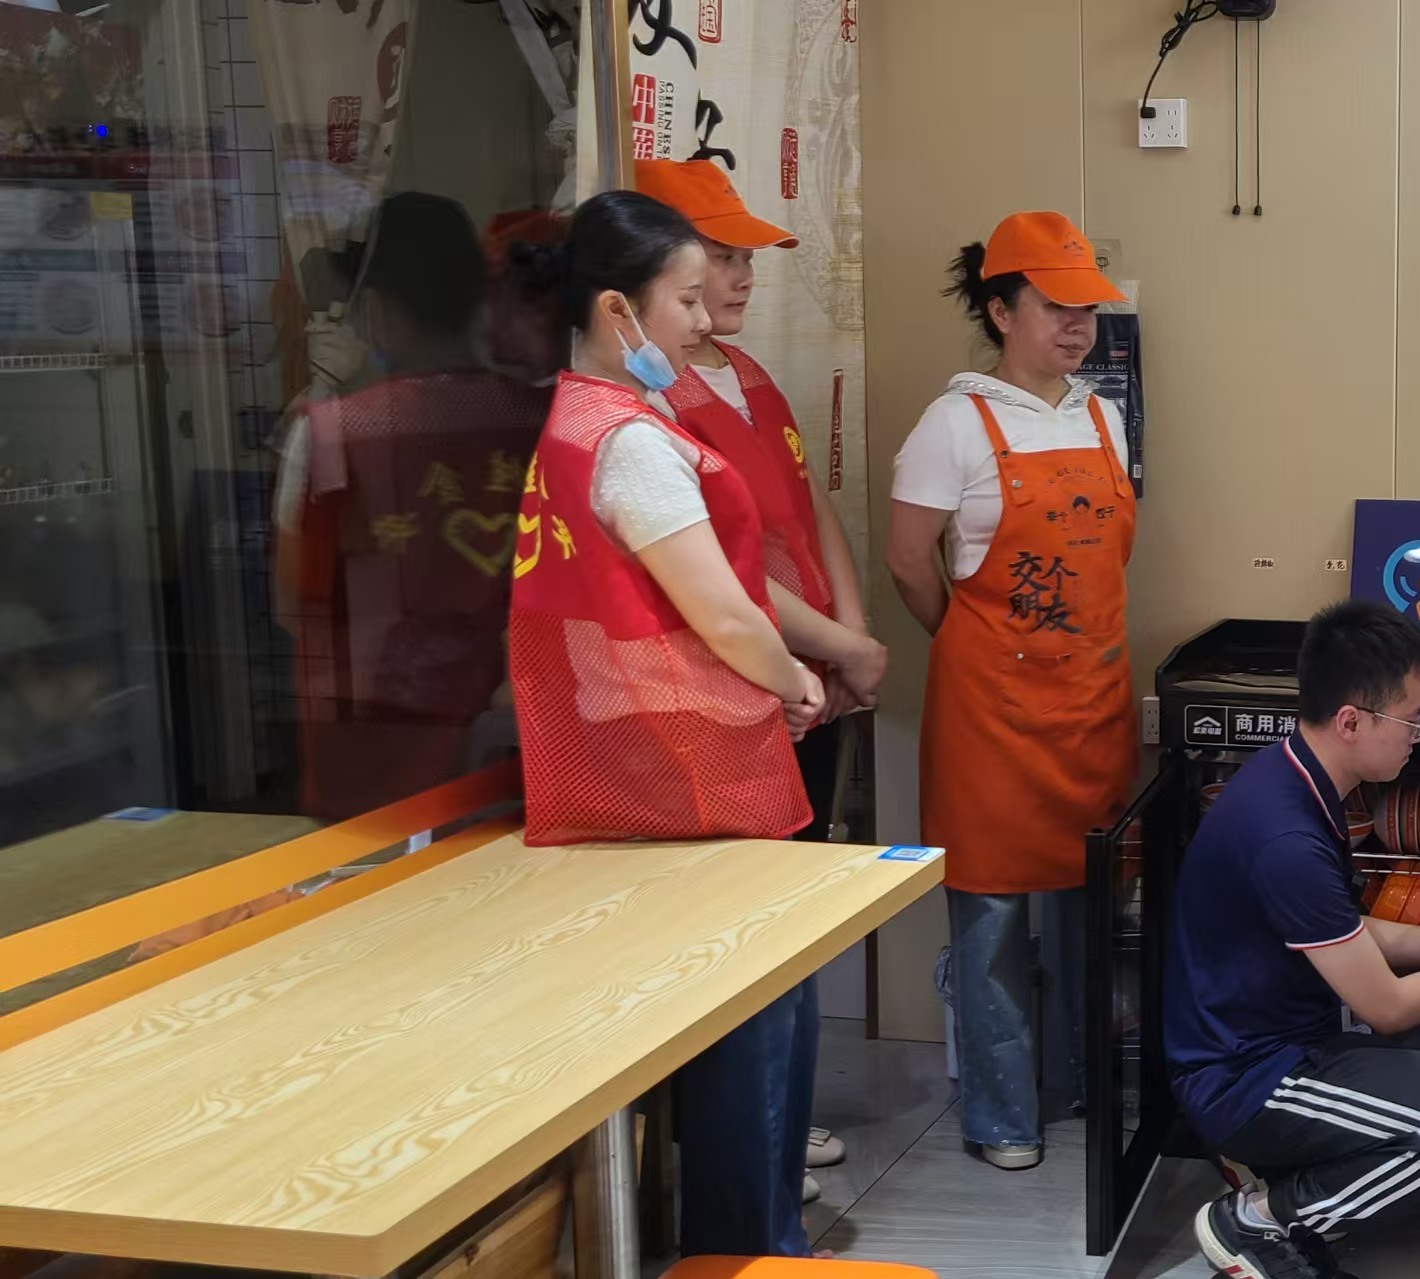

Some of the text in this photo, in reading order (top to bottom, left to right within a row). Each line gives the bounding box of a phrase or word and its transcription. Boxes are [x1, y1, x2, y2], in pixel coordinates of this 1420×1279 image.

[1008, 551, 1079, 593] 交个
[1008, 591, 1082, 634] 朋友
[1235, 713, 1297, 734] 商用消
[1235, 733, 1288, 742] COMMERCIA
